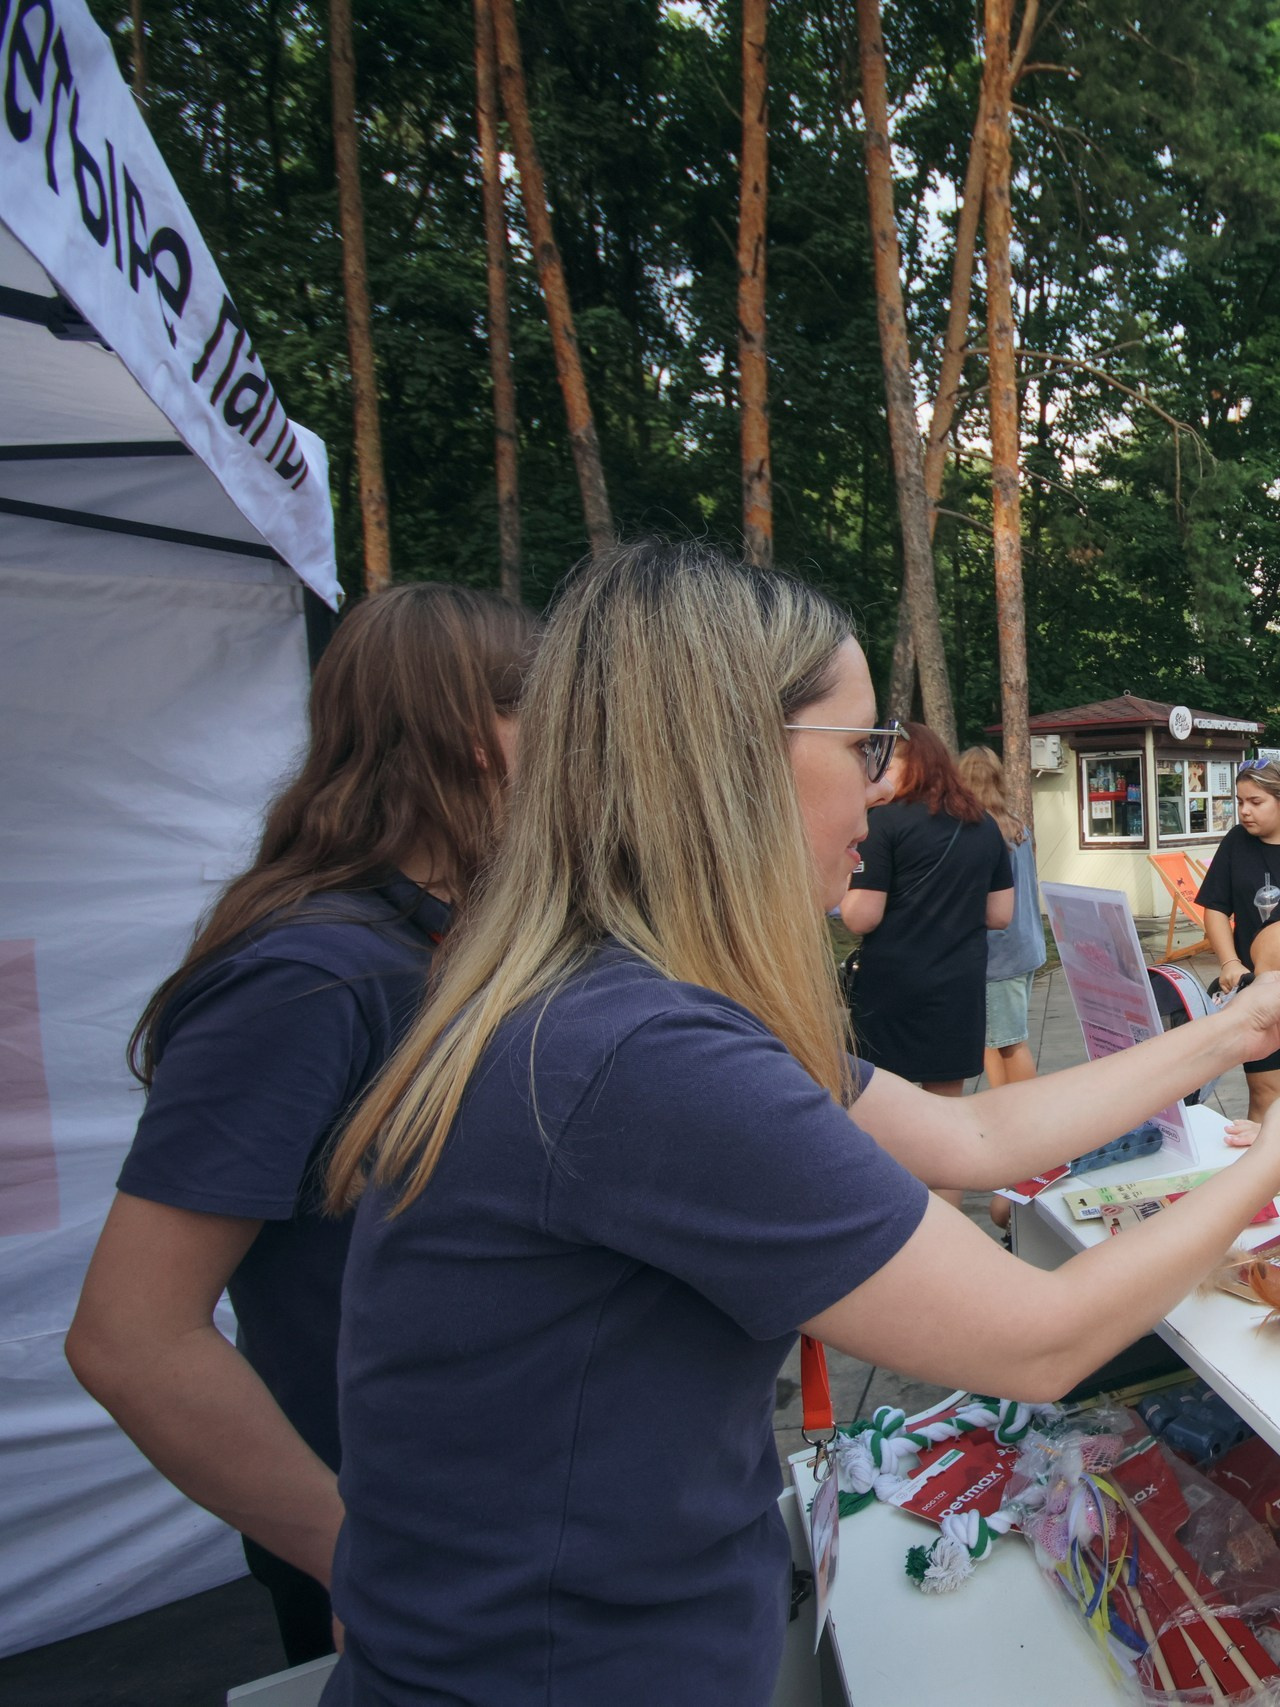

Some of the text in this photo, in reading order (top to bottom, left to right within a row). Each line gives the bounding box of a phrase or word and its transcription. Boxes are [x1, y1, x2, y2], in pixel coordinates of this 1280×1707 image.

[0, 0, 192, 350] етыре
[922, 1490, 947, 1512] DOG TOY
